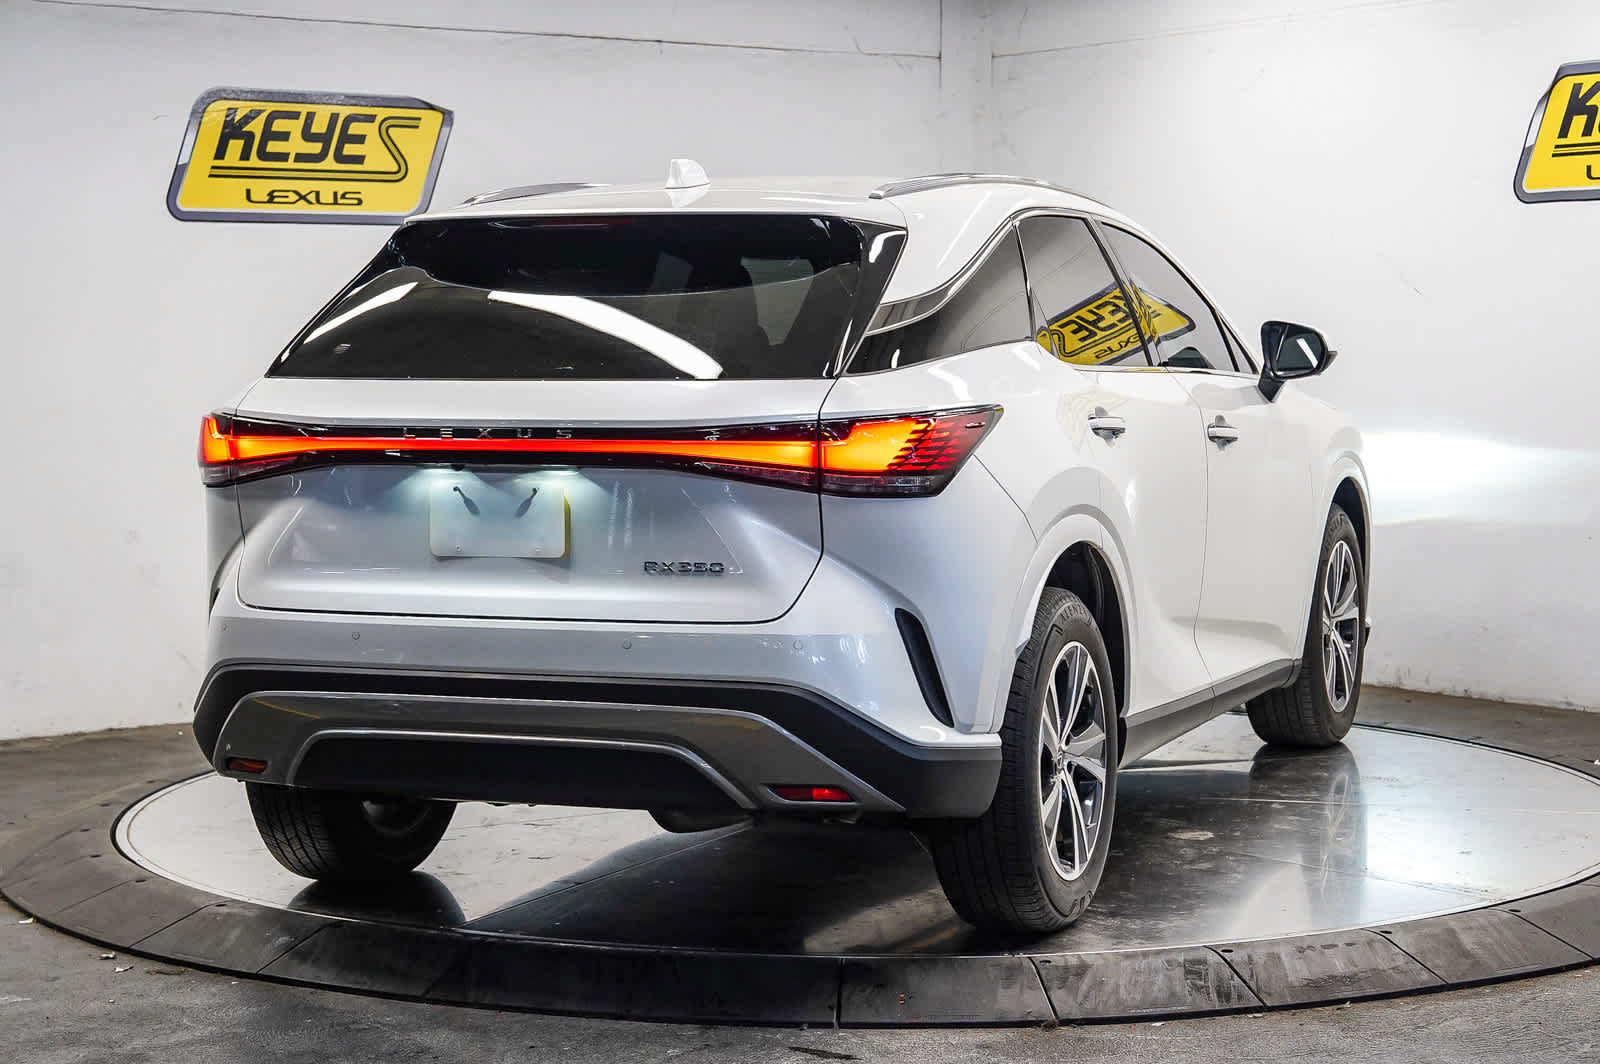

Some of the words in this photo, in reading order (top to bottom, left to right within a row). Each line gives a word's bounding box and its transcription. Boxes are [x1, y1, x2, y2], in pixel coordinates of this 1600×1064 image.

[208, 107, 421, 182] KEYES
[245, 188, 363, 206] LEXUS
[402, 427, 572, 440] LEXUS
